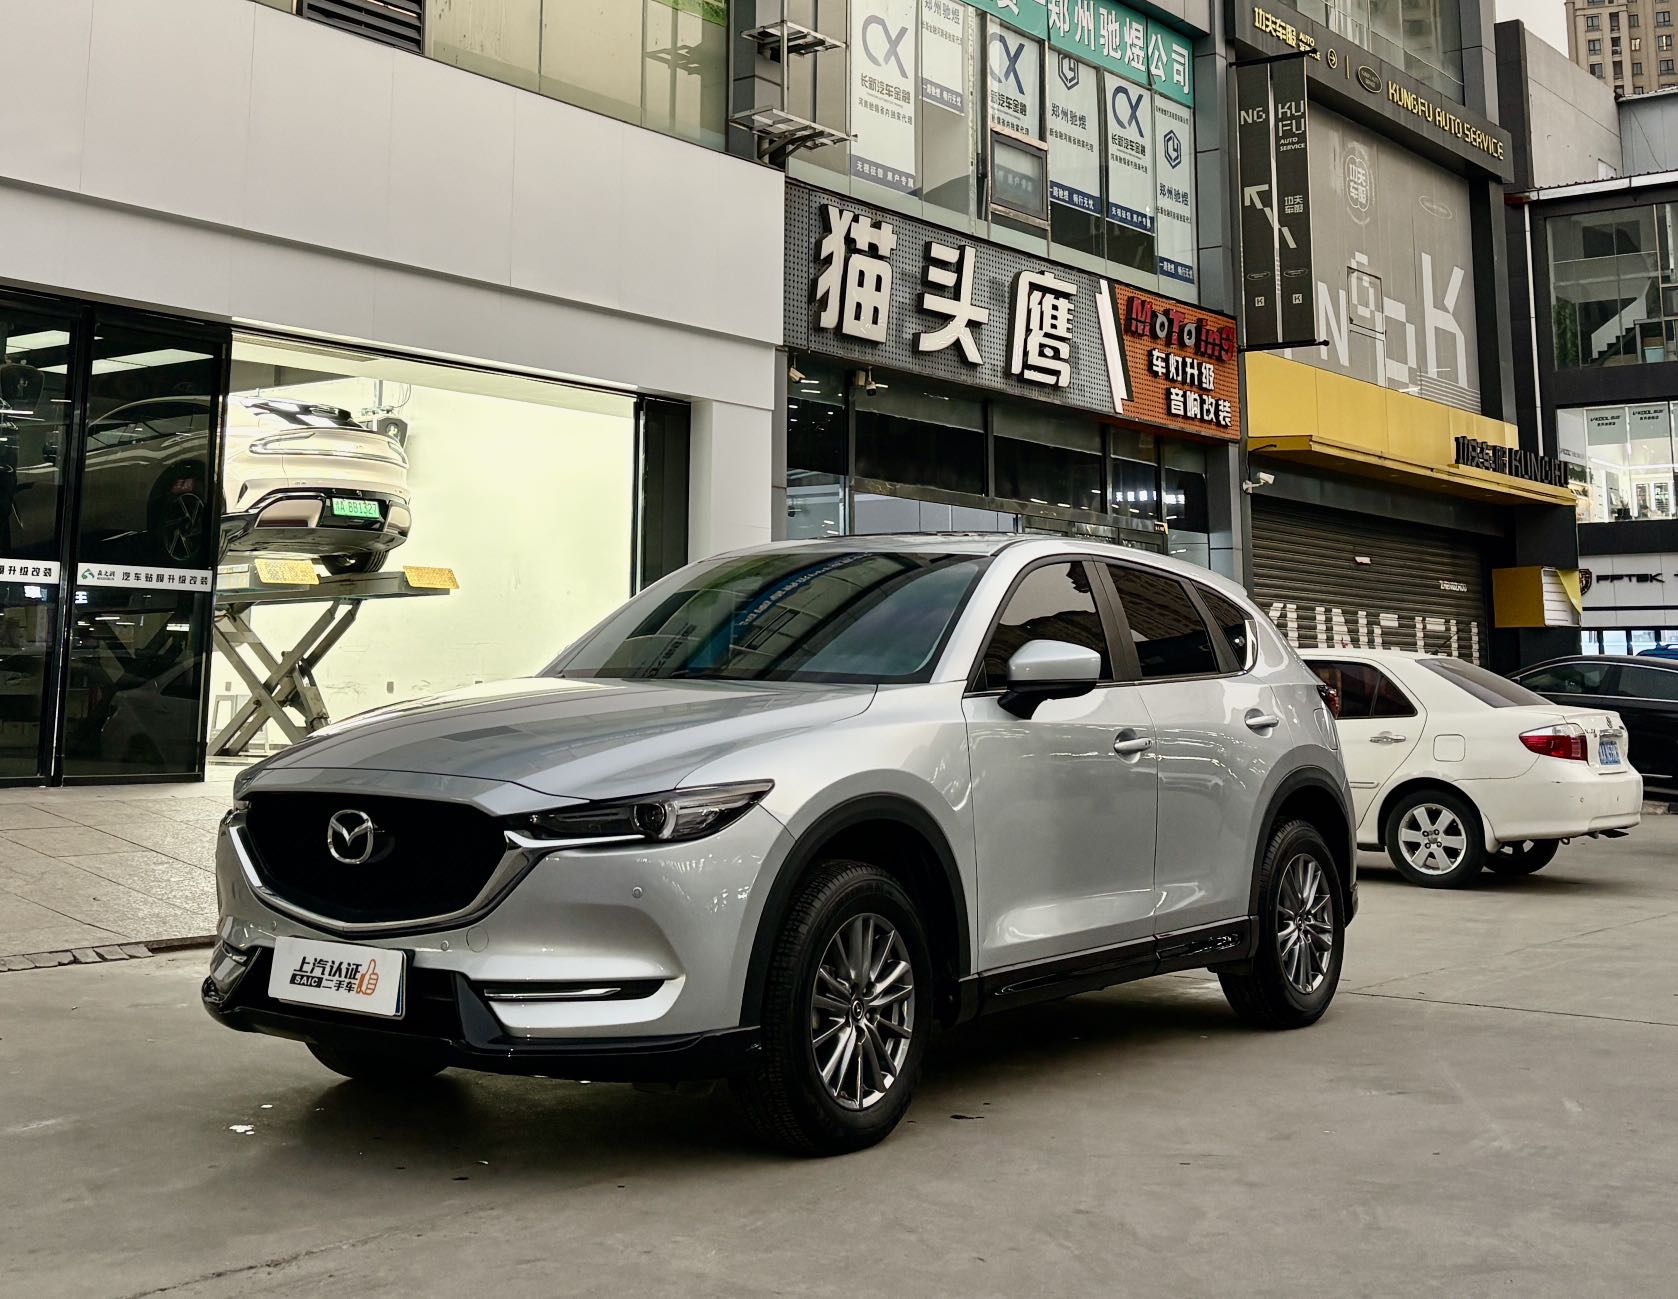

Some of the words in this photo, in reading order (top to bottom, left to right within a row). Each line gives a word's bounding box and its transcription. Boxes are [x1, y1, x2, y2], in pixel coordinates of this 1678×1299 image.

[1299, 32, 1315, 46] AUTO
[1388, 80, 1433, 121] KUNGFU
[1435, 108, 1463, 138] AUTO
[1464, 123, 1504, 160] SERVICE
[1280, 143, 1305, 151] SERVICE
[812, 203, 1079, 388] 猫头鹰
[1151, 348, 1214, 390] 车灯升级
[1169, 388, 1232, 427] 音响改装
[293, 956, 363, 980] 上汽认证
[294, 974, 319, 987] SAIC
[322, 978, 357, 993] 二手车
